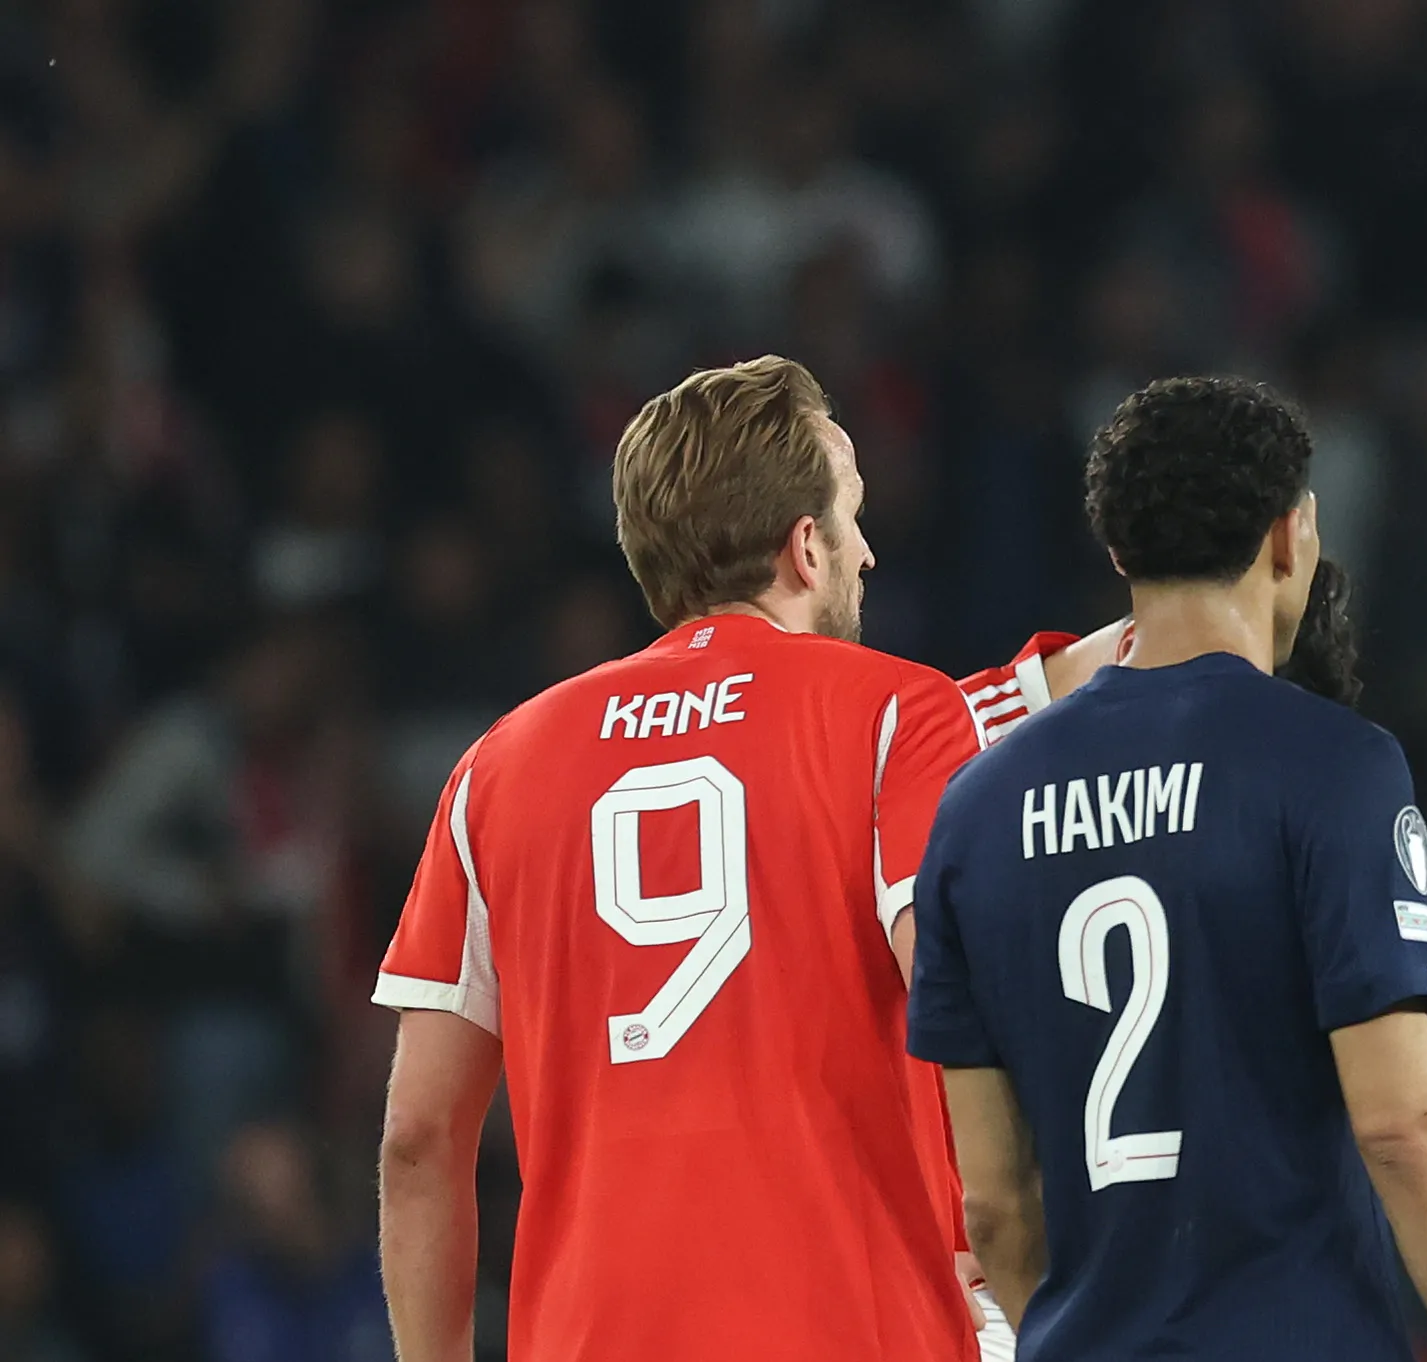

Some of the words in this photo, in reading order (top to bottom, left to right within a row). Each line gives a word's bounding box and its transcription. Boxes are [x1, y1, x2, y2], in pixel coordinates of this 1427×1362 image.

[600, 673, 754, 739] KANE
[591, 755, 752, 1064] 9
[1022, 762, 1203, 859] HAKIMI
[1058, 875, 1183, 1192] 2
